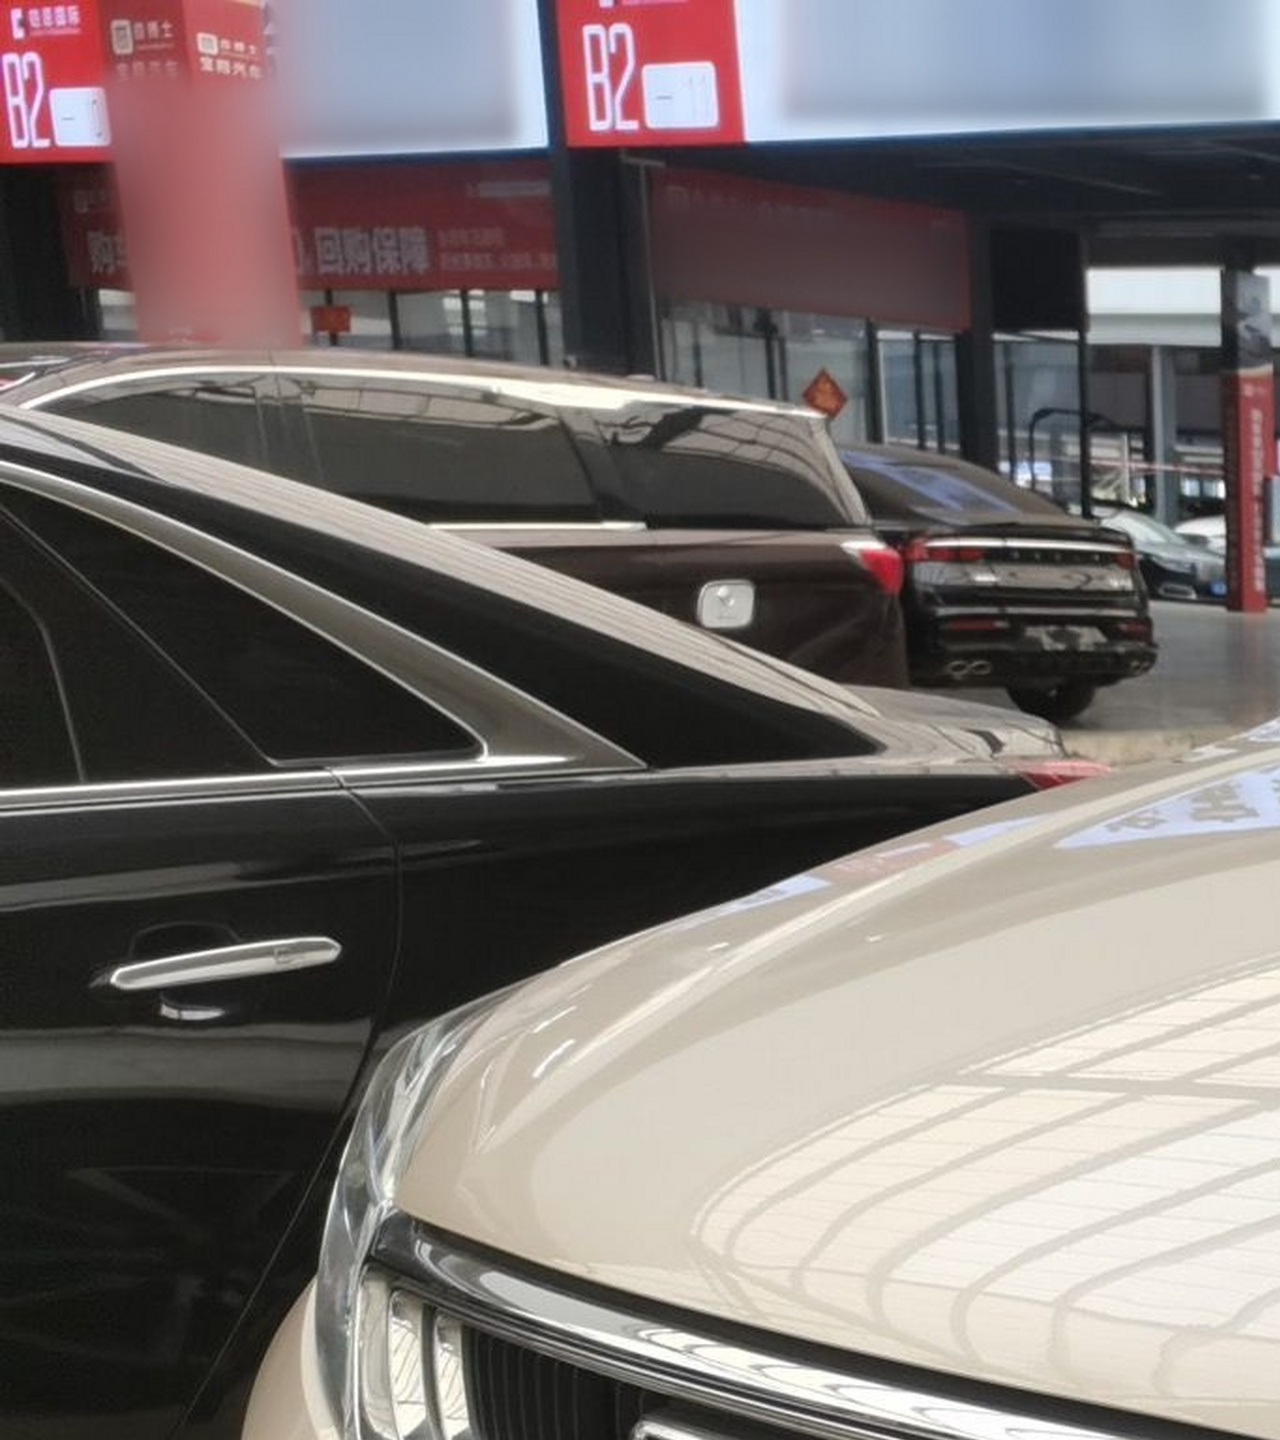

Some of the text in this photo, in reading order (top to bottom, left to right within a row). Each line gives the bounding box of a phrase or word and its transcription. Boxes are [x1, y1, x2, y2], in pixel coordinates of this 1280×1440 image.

[2, 52, 50, 148] B2
[582, 23, 639, 131] B2
[314, 226, 431, 275] 回购保障
